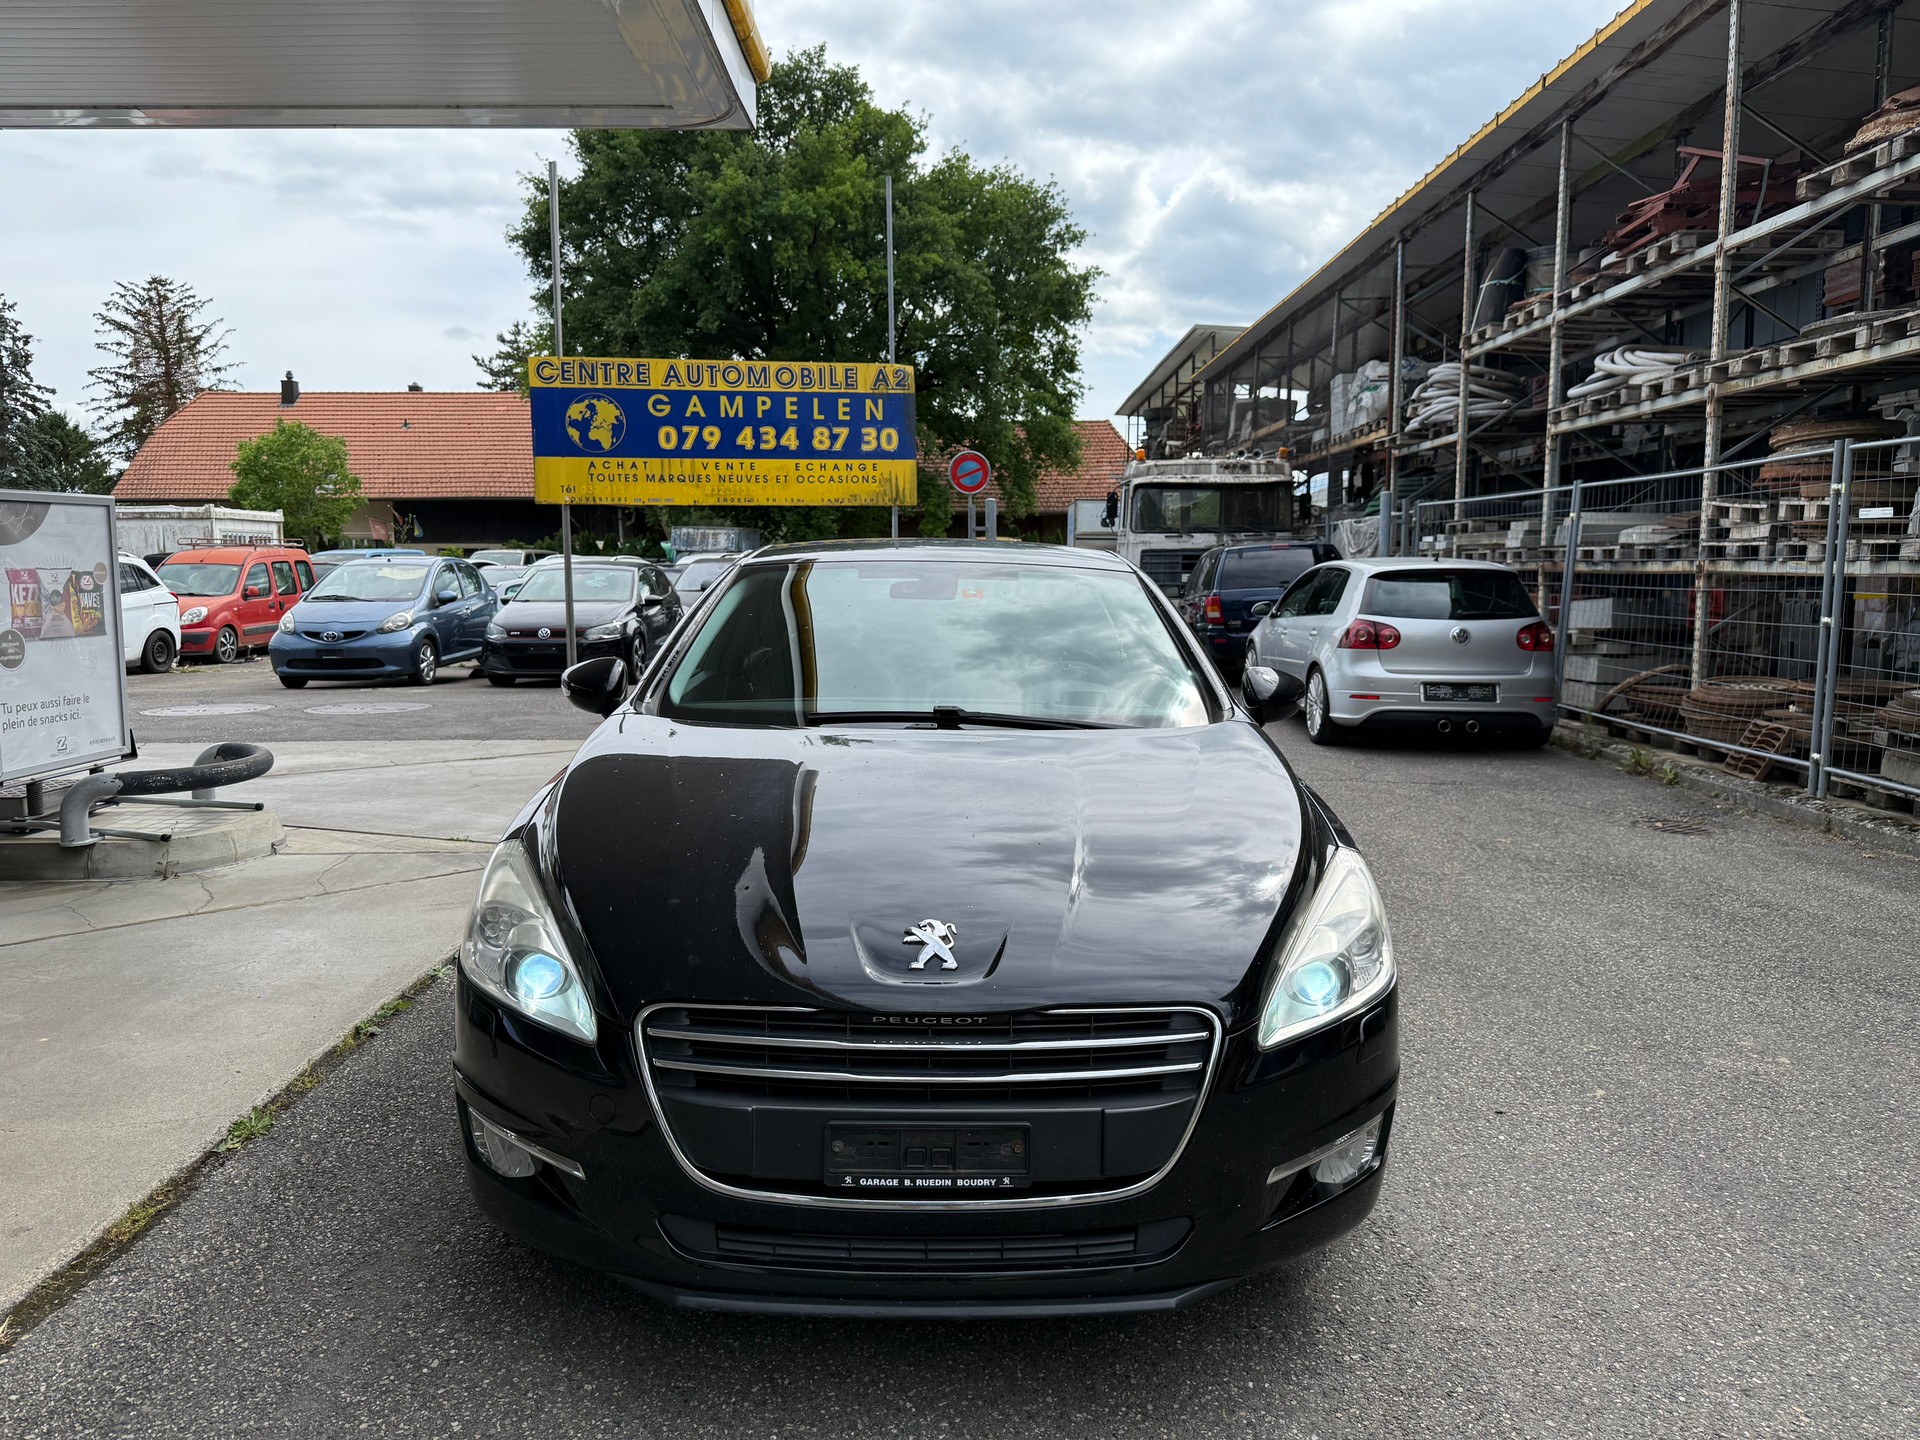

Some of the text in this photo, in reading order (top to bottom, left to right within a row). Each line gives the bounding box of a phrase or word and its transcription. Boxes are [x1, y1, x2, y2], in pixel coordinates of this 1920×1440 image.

[535, 360, 910, 391] CENTRE AUTOMOBILE A2
[647, 394, 884, 420] GAMPELEN
[658, 425, 899, 451] 079 434 87 30
[589, 460, 878, 471] ACHAT VENTE ECHANGE
[589, 473, 877, 484] TOUTES MARQUES NEUVES ET OCCASIONS
[560, 485, 576, 493] Tél
[0, 693, 90, 715] Tu peux aussi faire le
[2, 709, 81, 733] plein de snacks ici.
[872, 1016, 988, 1024] PEUGEOT
[859, 1178, 899, 1186] GARAGE
[904, 1178, 914, 1186] B.
[916, 1178, 952, 1186] RUEDIN
